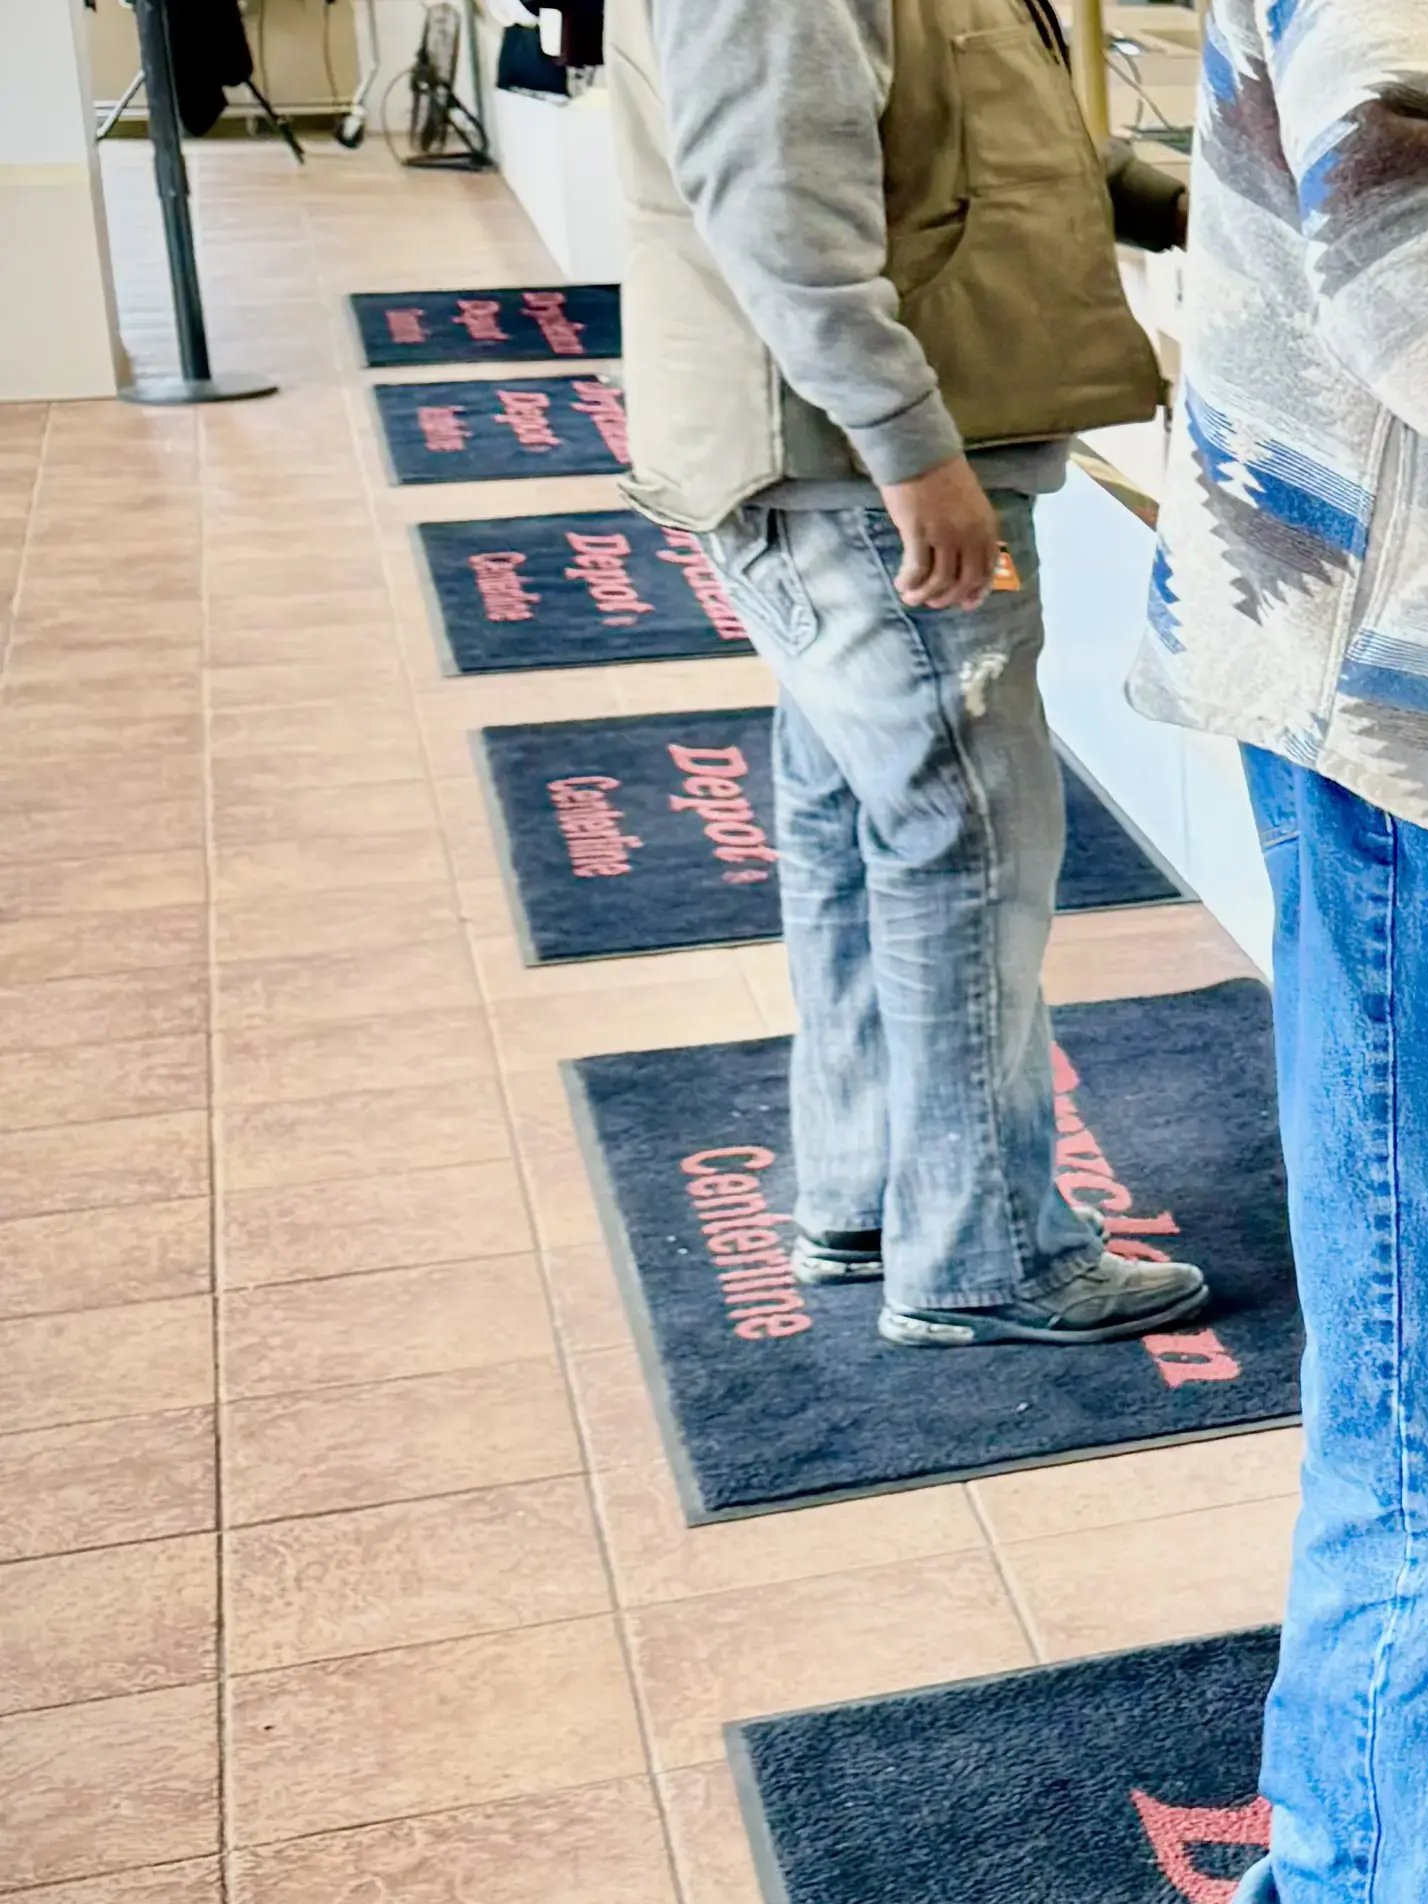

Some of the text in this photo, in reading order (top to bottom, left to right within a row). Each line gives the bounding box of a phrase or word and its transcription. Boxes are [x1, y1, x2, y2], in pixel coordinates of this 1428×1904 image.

[564, 530, 655, 614] Depot
[667, 743, 781, 864] Depot
[679, 1146, 813, 1341] Centerline
